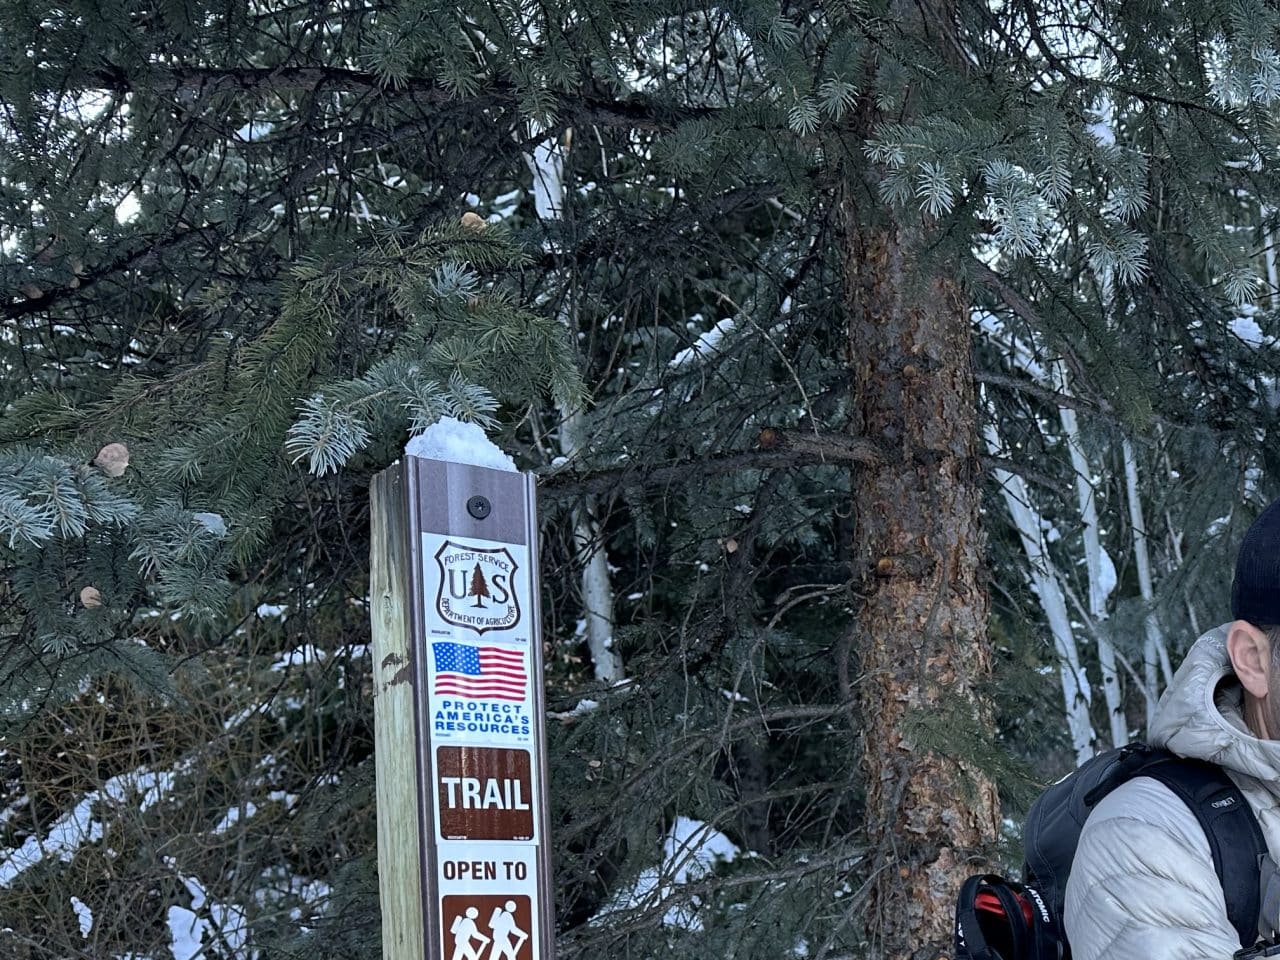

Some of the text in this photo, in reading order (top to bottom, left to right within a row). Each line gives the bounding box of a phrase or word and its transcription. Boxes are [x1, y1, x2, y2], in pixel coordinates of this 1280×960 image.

[445, 553, 510, 574] FOREST SERVICE
[441, 598, 516, 626] DEPARTMENT OF AGRICULTURE
[443, 700, 522, 714] PROTECT
[435, 711, 530, 725] AMERICA'S
[435, 722, 530, 735] RESOURCES
[441, 777, 530, 810] TRAIL
[443, 860, 527, 880] OPEN TO
[1028, 889, 1051, 923] ATOMIC
